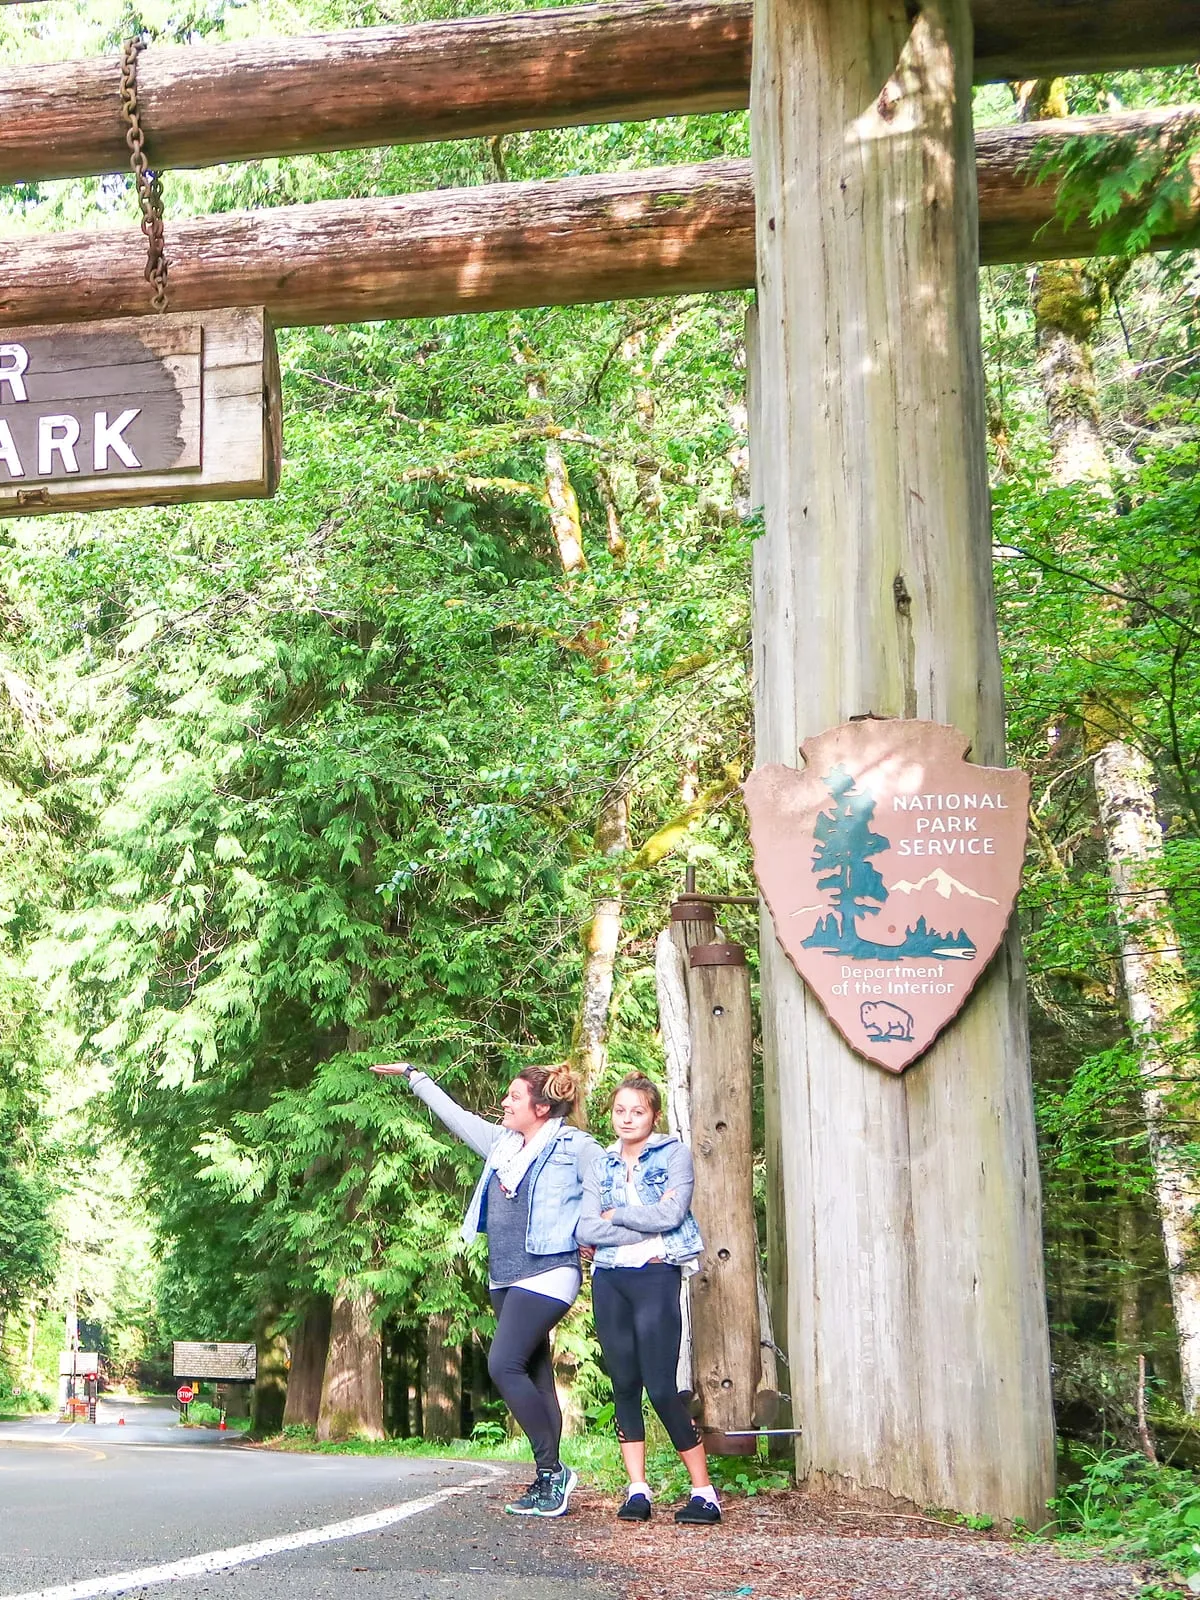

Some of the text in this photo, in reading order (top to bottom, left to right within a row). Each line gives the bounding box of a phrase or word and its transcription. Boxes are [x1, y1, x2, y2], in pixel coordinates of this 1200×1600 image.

[893, 793, 1009, 811] NATIONAL
[916, 816, 977, 833] PARK
[897, 838, 995, 856] SERVICE
[841, 964, 944, 980] Department
[831, 981, 954, 995] of the Interior
